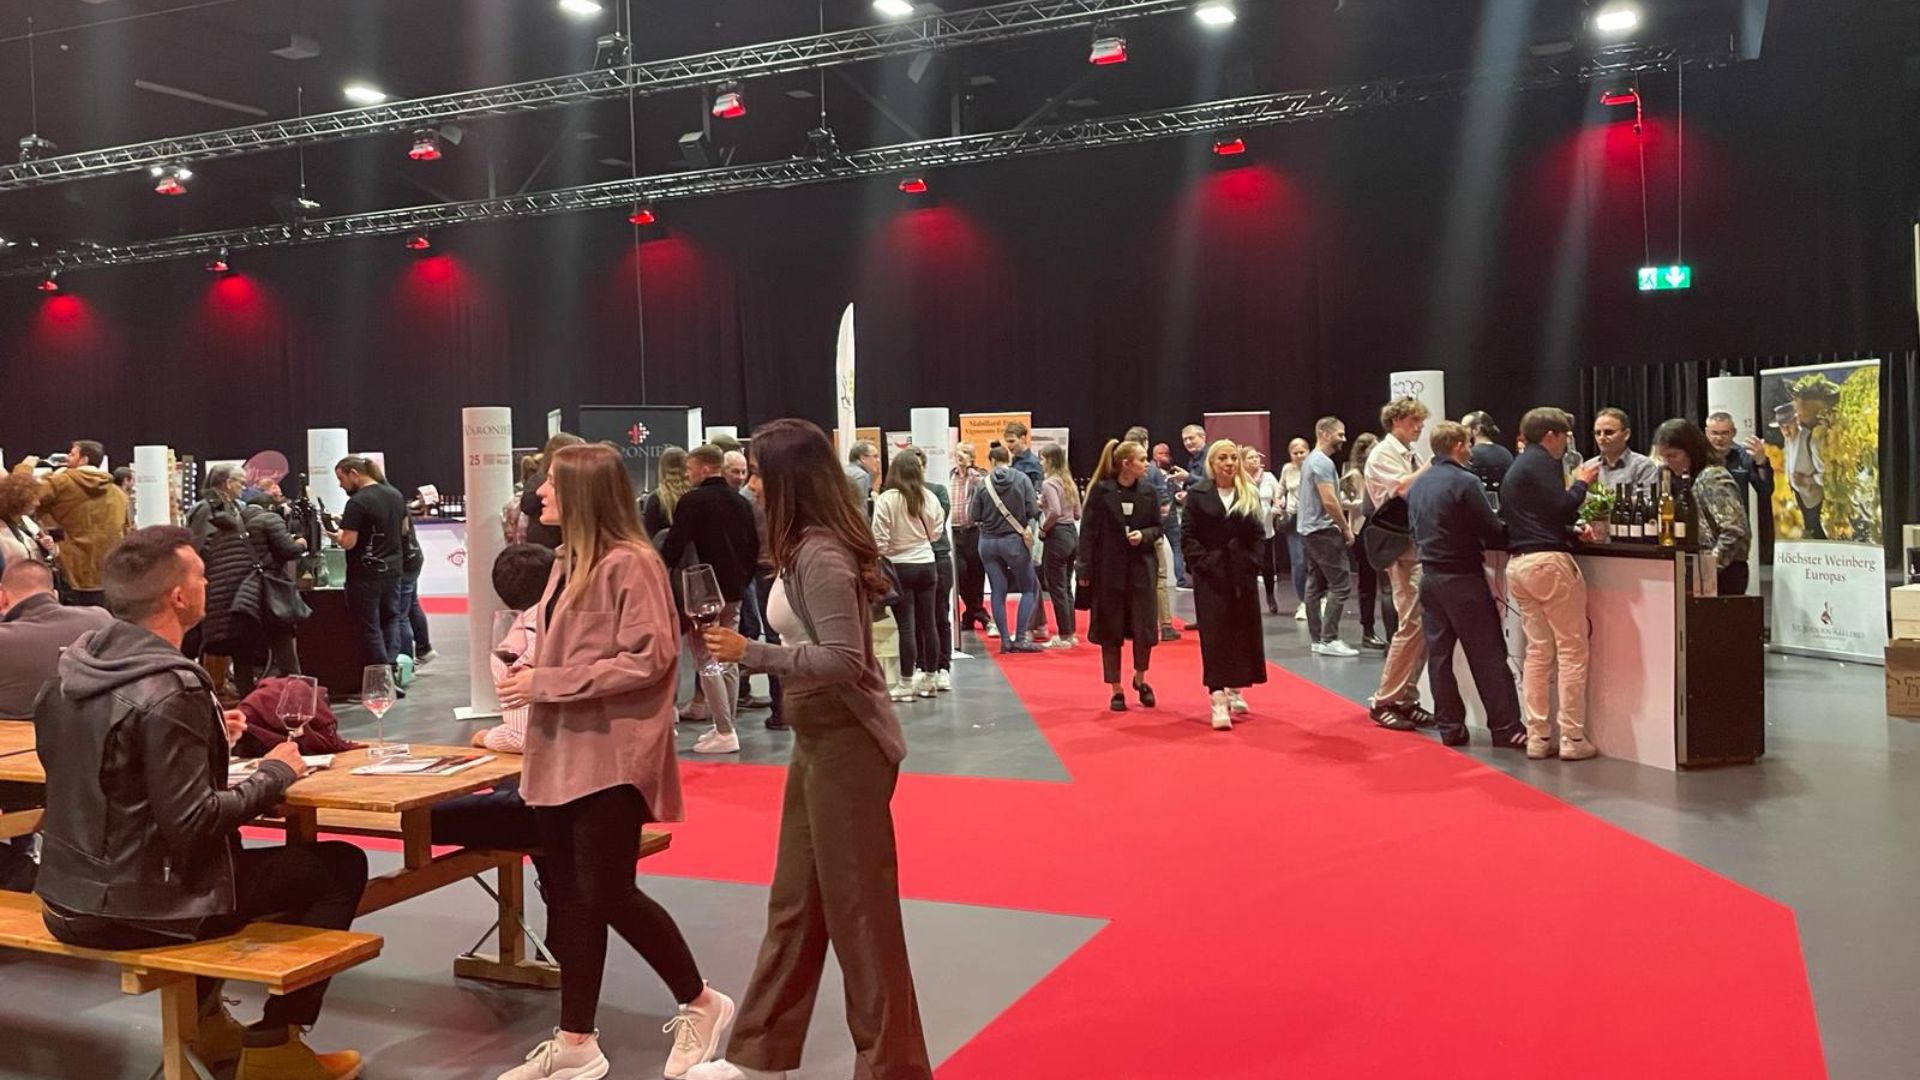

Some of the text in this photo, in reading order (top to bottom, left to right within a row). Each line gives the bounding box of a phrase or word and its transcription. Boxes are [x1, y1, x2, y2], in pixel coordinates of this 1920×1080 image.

[470, 454, 480, 466] 25
[1778, 552, 1876, 572] Höchster Weinberg
[1805, 568, 1847, 584] Europas
